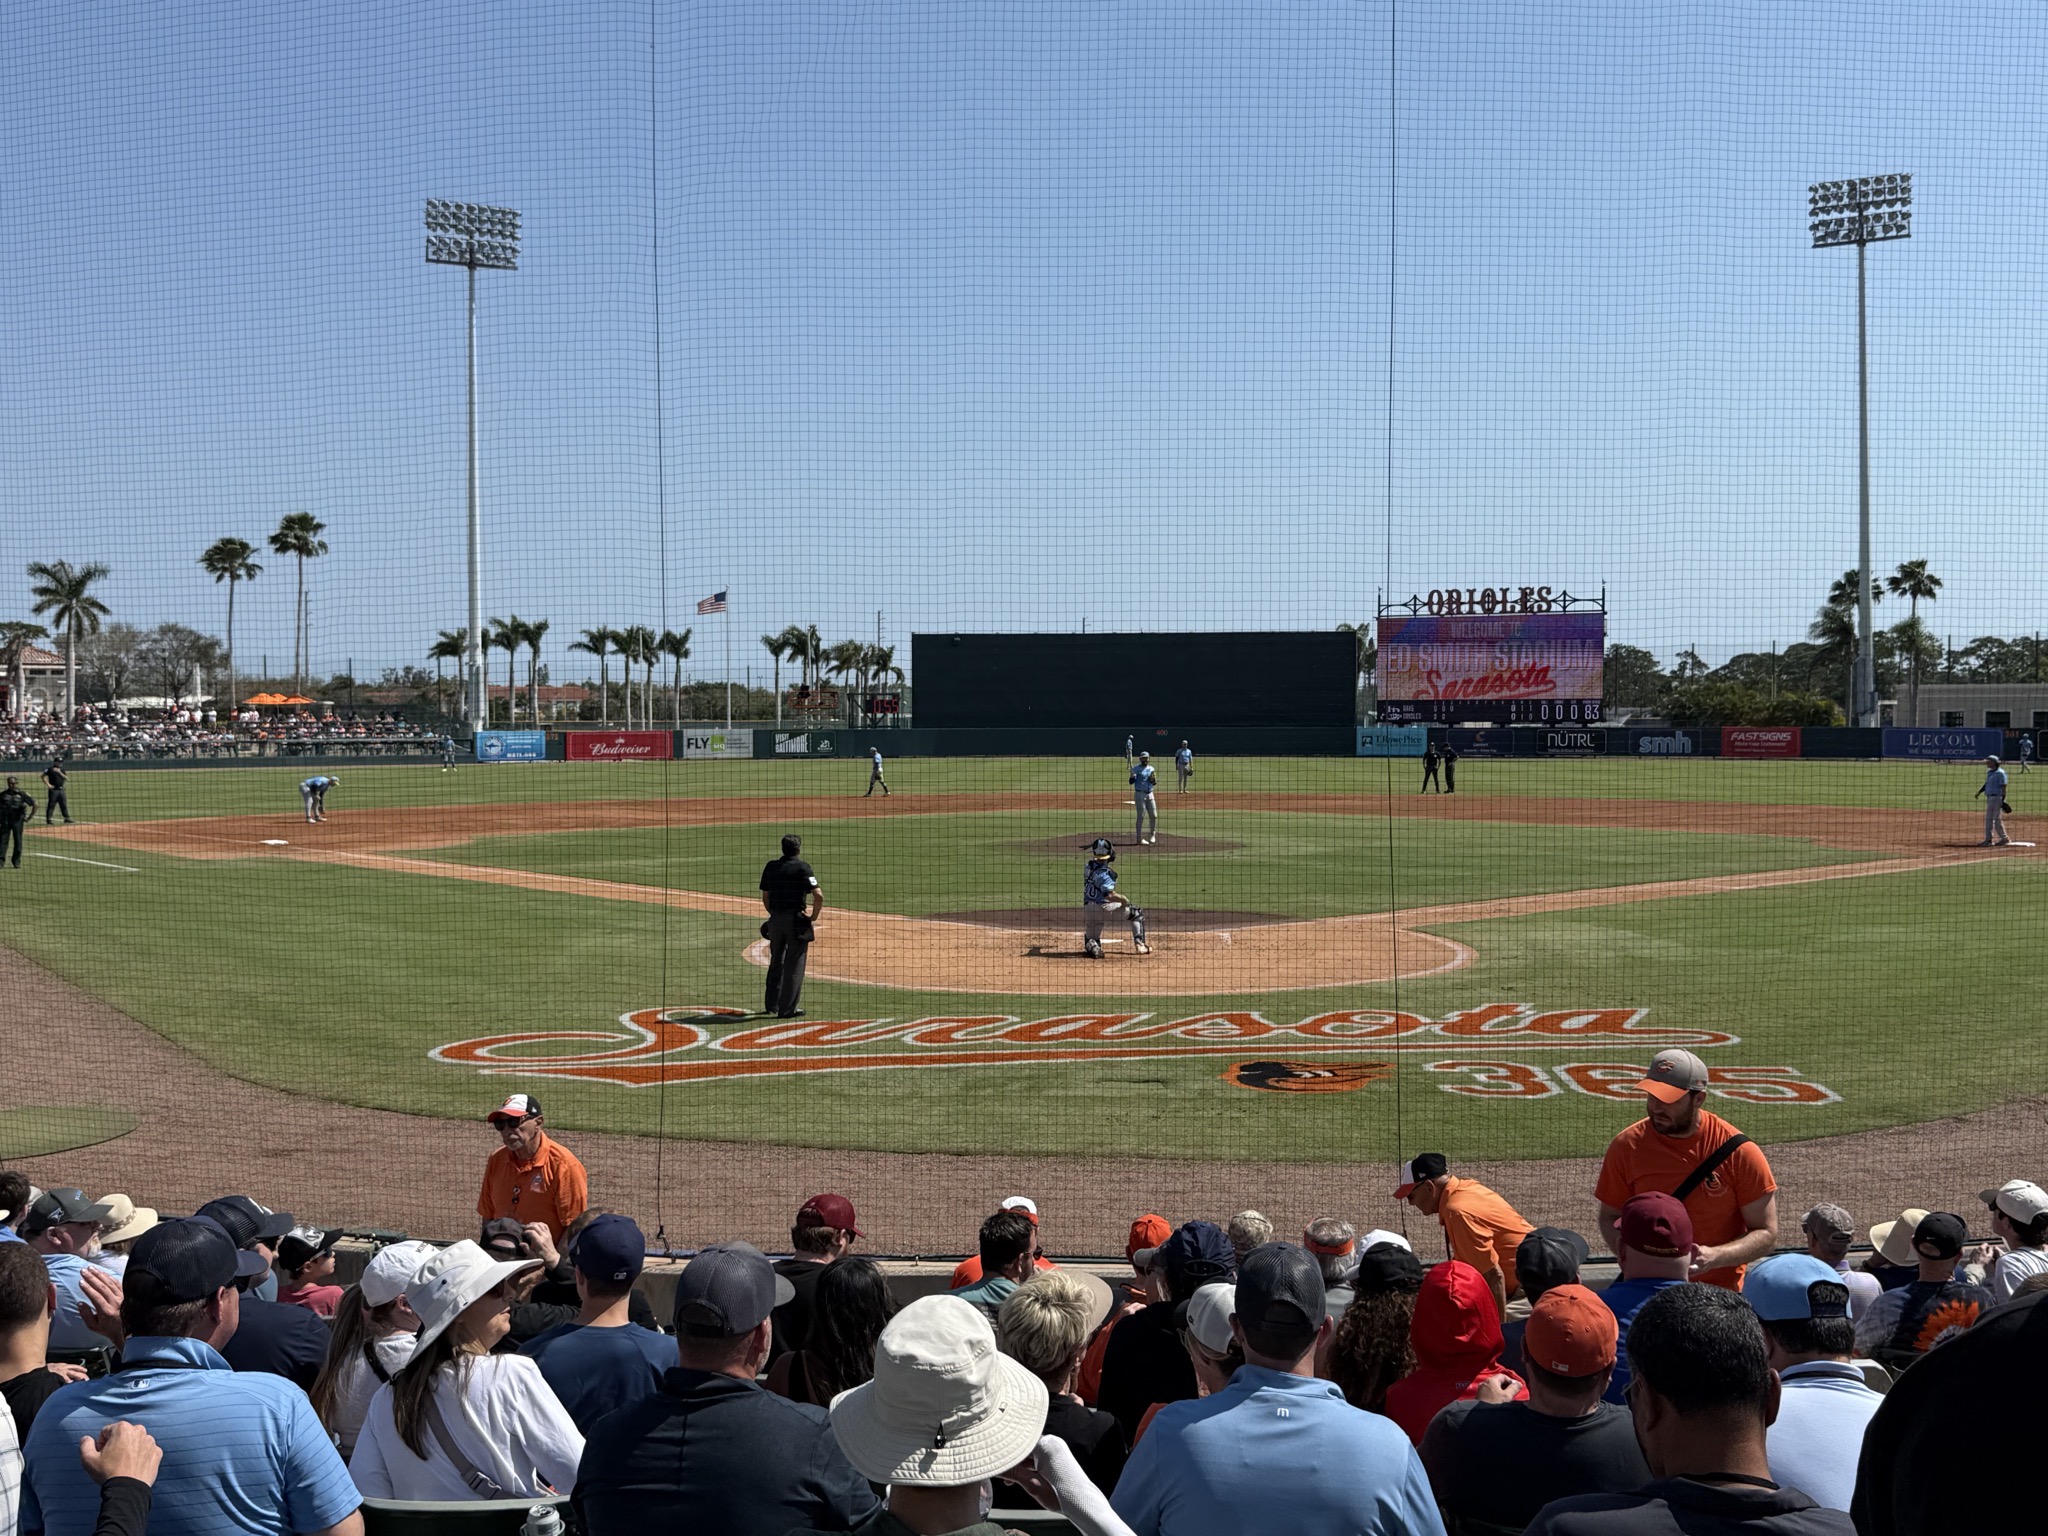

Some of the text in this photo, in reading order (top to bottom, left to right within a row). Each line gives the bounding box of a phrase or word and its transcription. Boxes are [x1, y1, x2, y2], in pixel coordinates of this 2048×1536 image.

[1427, 586, 1552, 615] ORIOLES
[1450, 622, 1505, 637] WELCOME
[1388, 638, 1598, 672] ED SMITH STADIUM
[1412, 661, 1556, 700] Sarasota
[1541, 704, 1600, 720] 0 0 0 83
[687, 737, 710, 749] FLY
[775, 733, 789, 743] VISIT
[775, 733, 809, 753] BALTIMORE
[1639, 730, 1691, 753] smh
[1730, 732, 1792, 741] FASTSIGNS
[1909, 734, 1976, 746] LECOM
[589, 743, 651, 755] Budweiser
[427, 1003, 1741, 1087] Sarasota
[1422, 1059, 1843, 1105] 365
